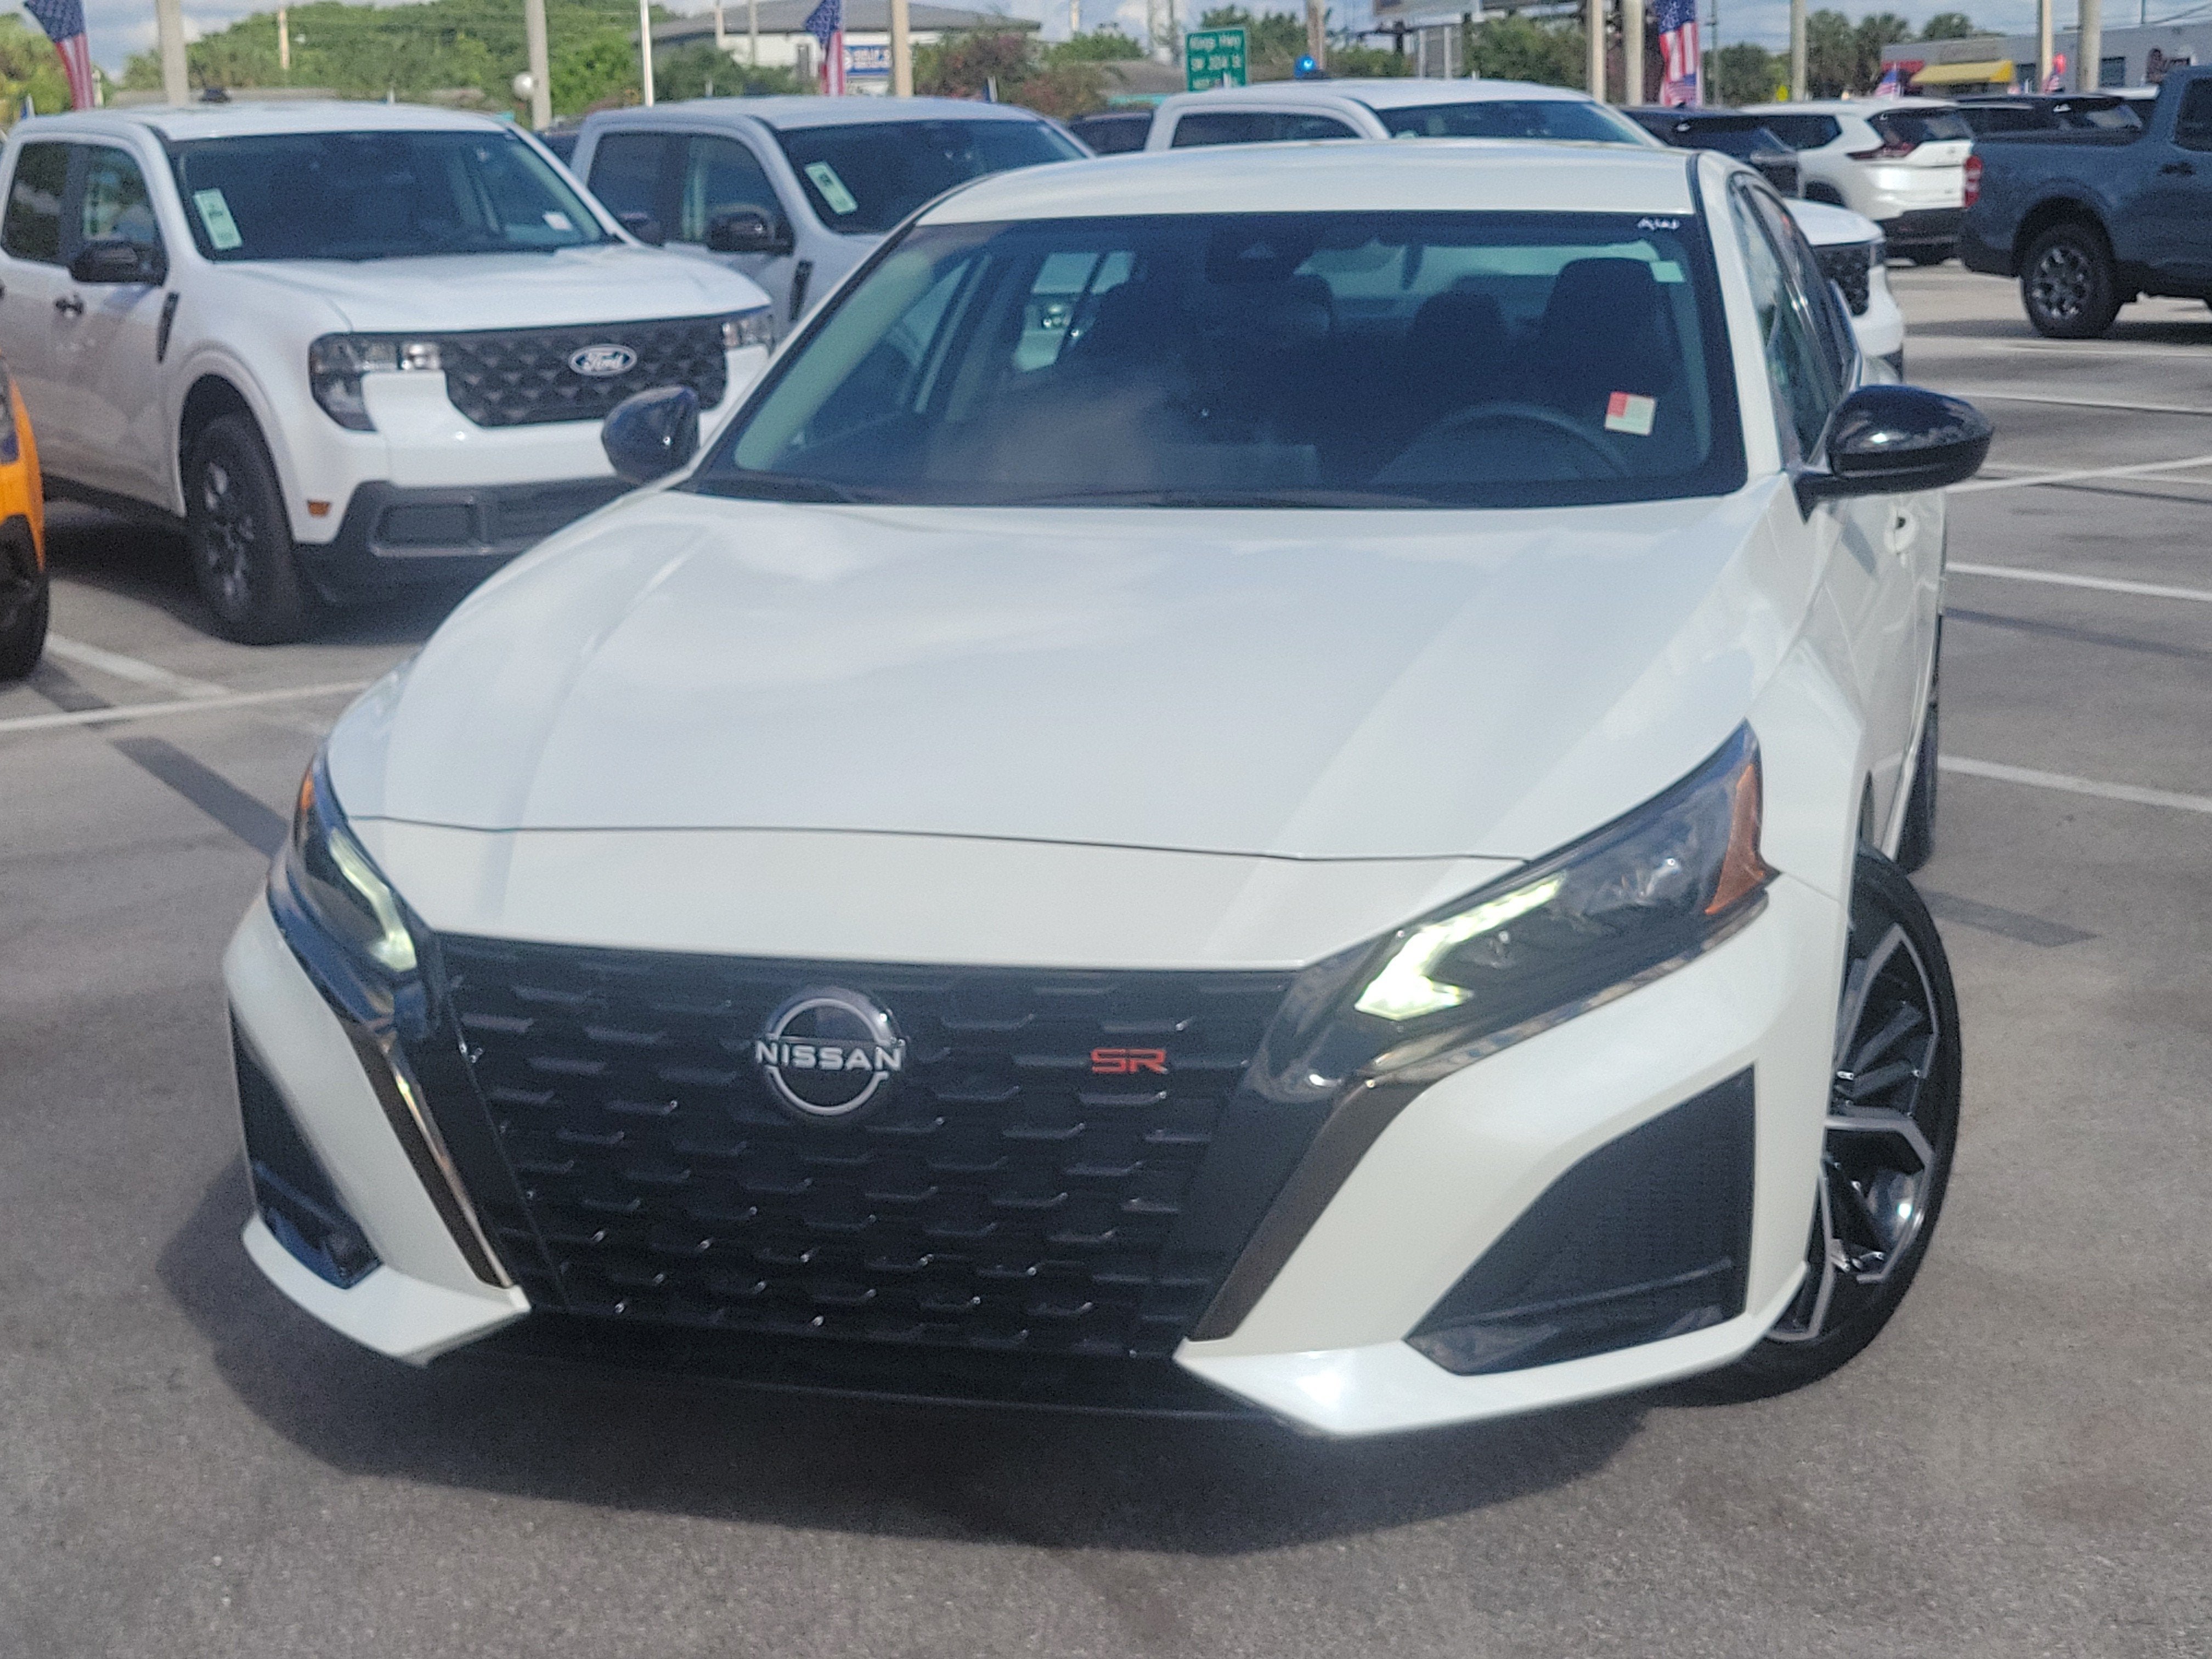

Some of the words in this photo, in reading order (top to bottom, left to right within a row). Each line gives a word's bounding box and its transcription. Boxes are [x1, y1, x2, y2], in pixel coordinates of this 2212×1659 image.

[583, 351, 624, 371] Ford
[755, 1040, 902, 1071] NISSAN
[1091, 1047, 1169, 1074] SR
